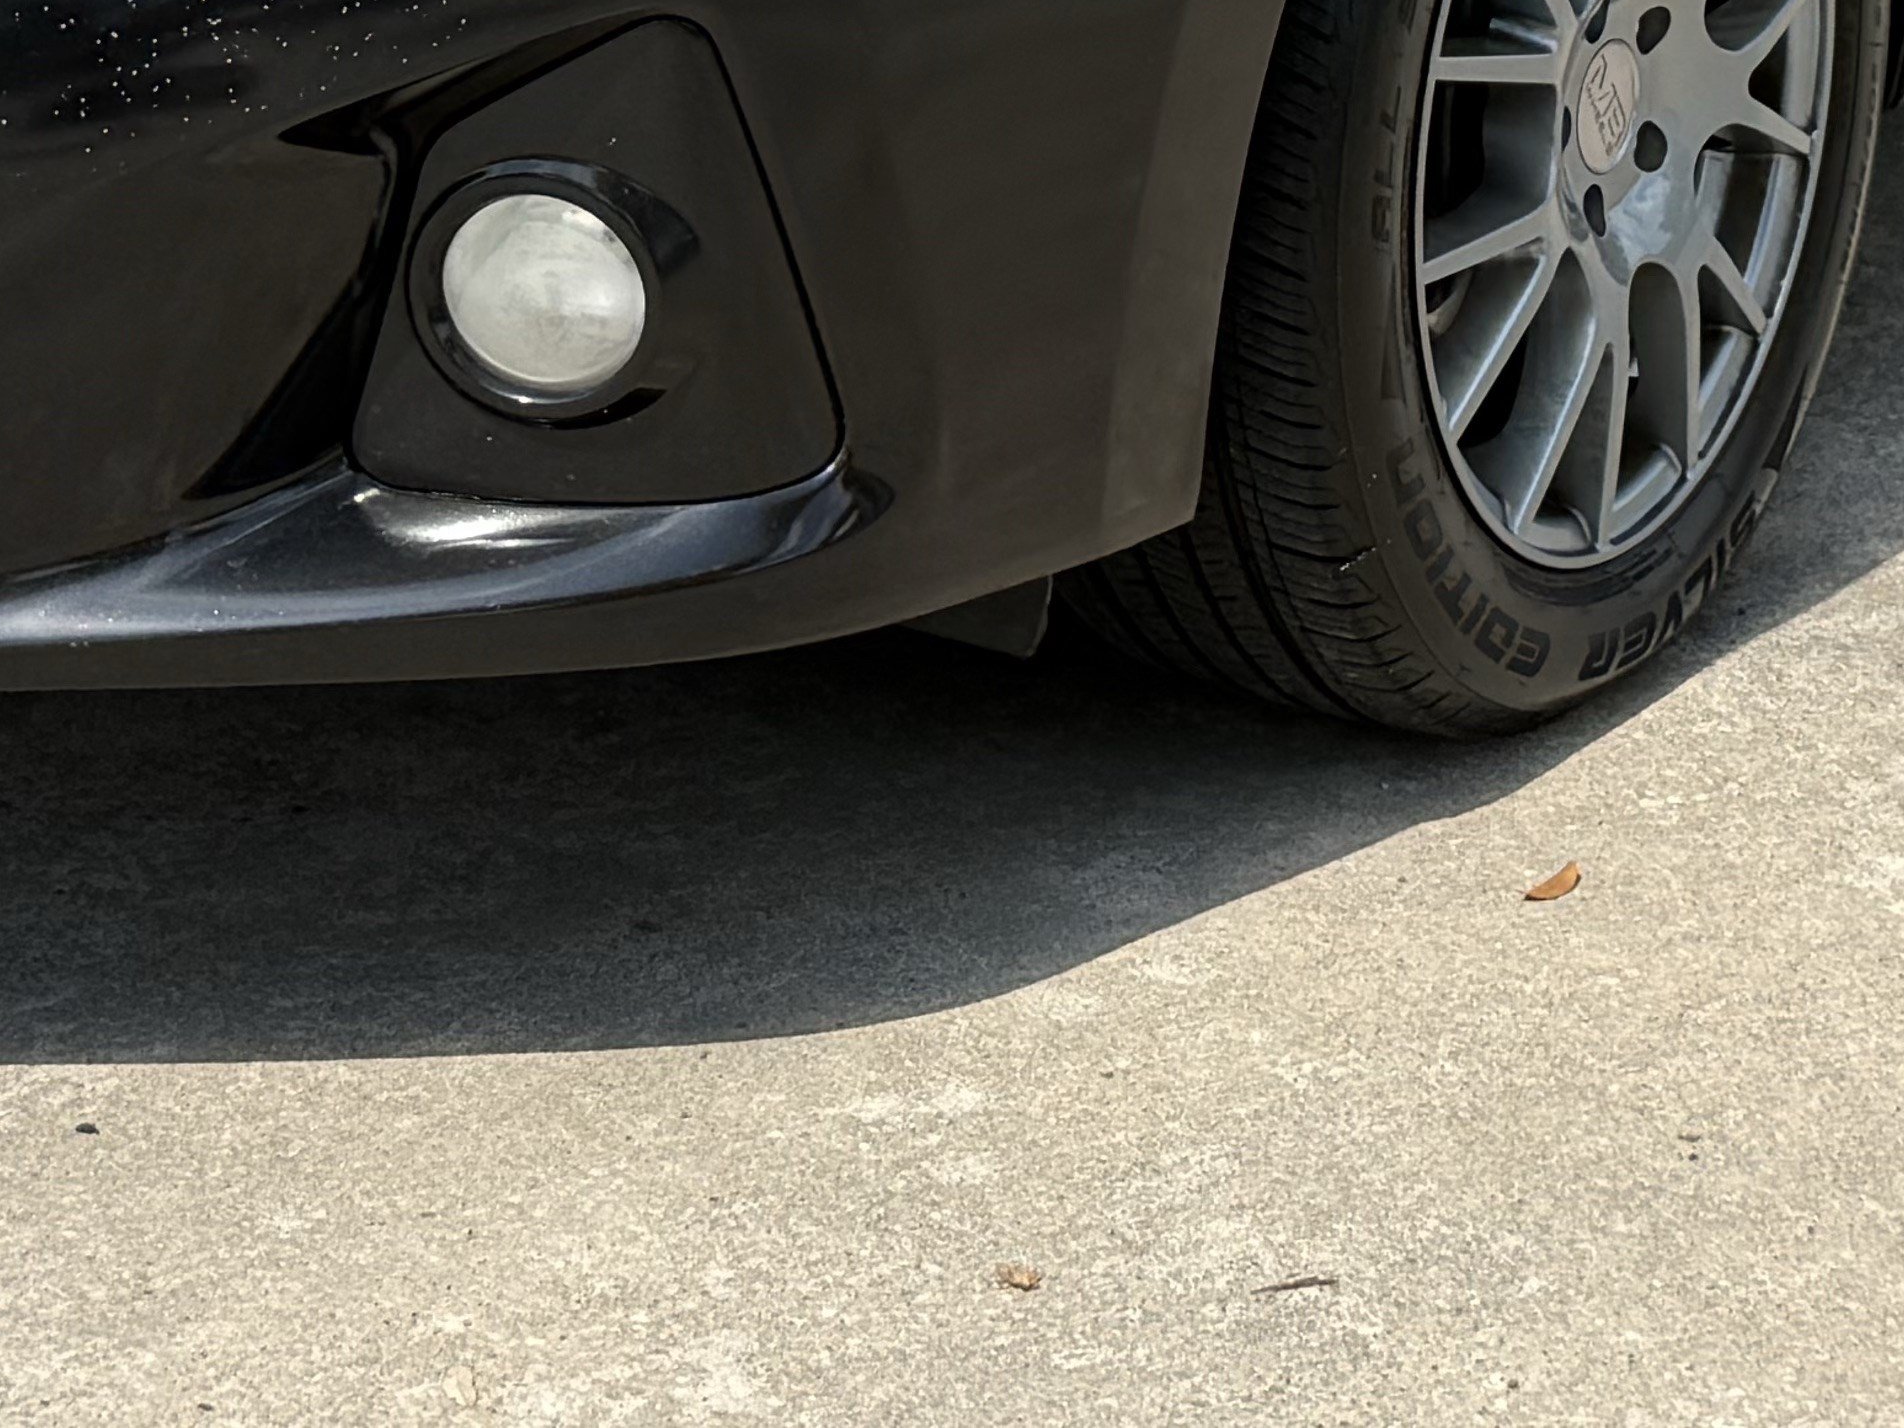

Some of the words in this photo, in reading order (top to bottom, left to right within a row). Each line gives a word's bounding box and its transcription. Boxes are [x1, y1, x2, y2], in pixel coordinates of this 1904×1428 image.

[1372, 85, 1402, 243] ALL
[1384, 440, 1552, 679] EDITION
[1577, 489, 1757, 682] SILVER
